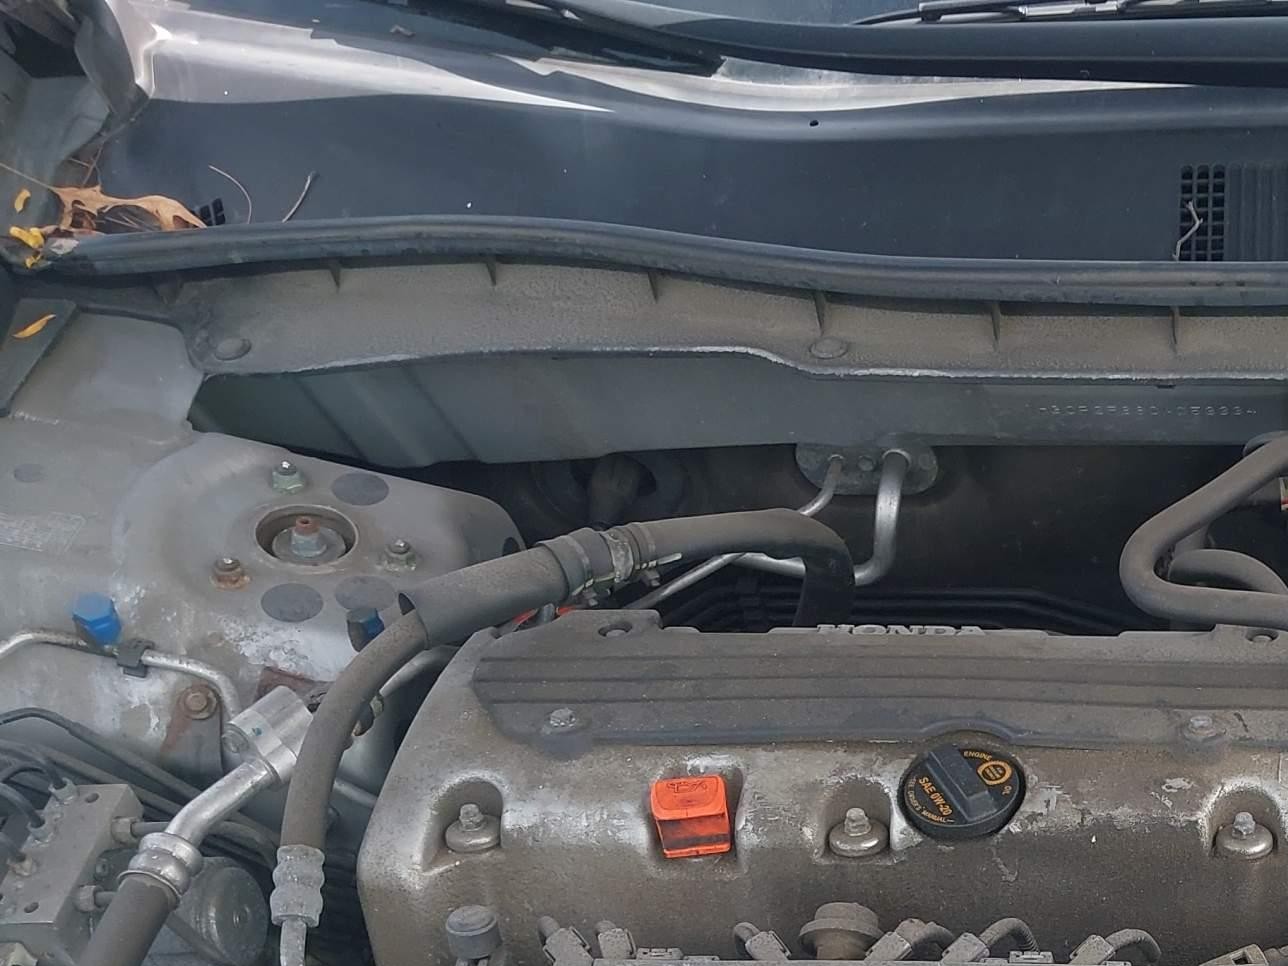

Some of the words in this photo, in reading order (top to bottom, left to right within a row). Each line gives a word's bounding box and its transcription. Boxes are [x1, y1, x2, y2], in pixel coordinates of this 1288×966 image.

[963, 750, 993, 761] ENGINE
[918, 776, 937, 795] SAE
[930, 792, 953, 816] 0W-20
